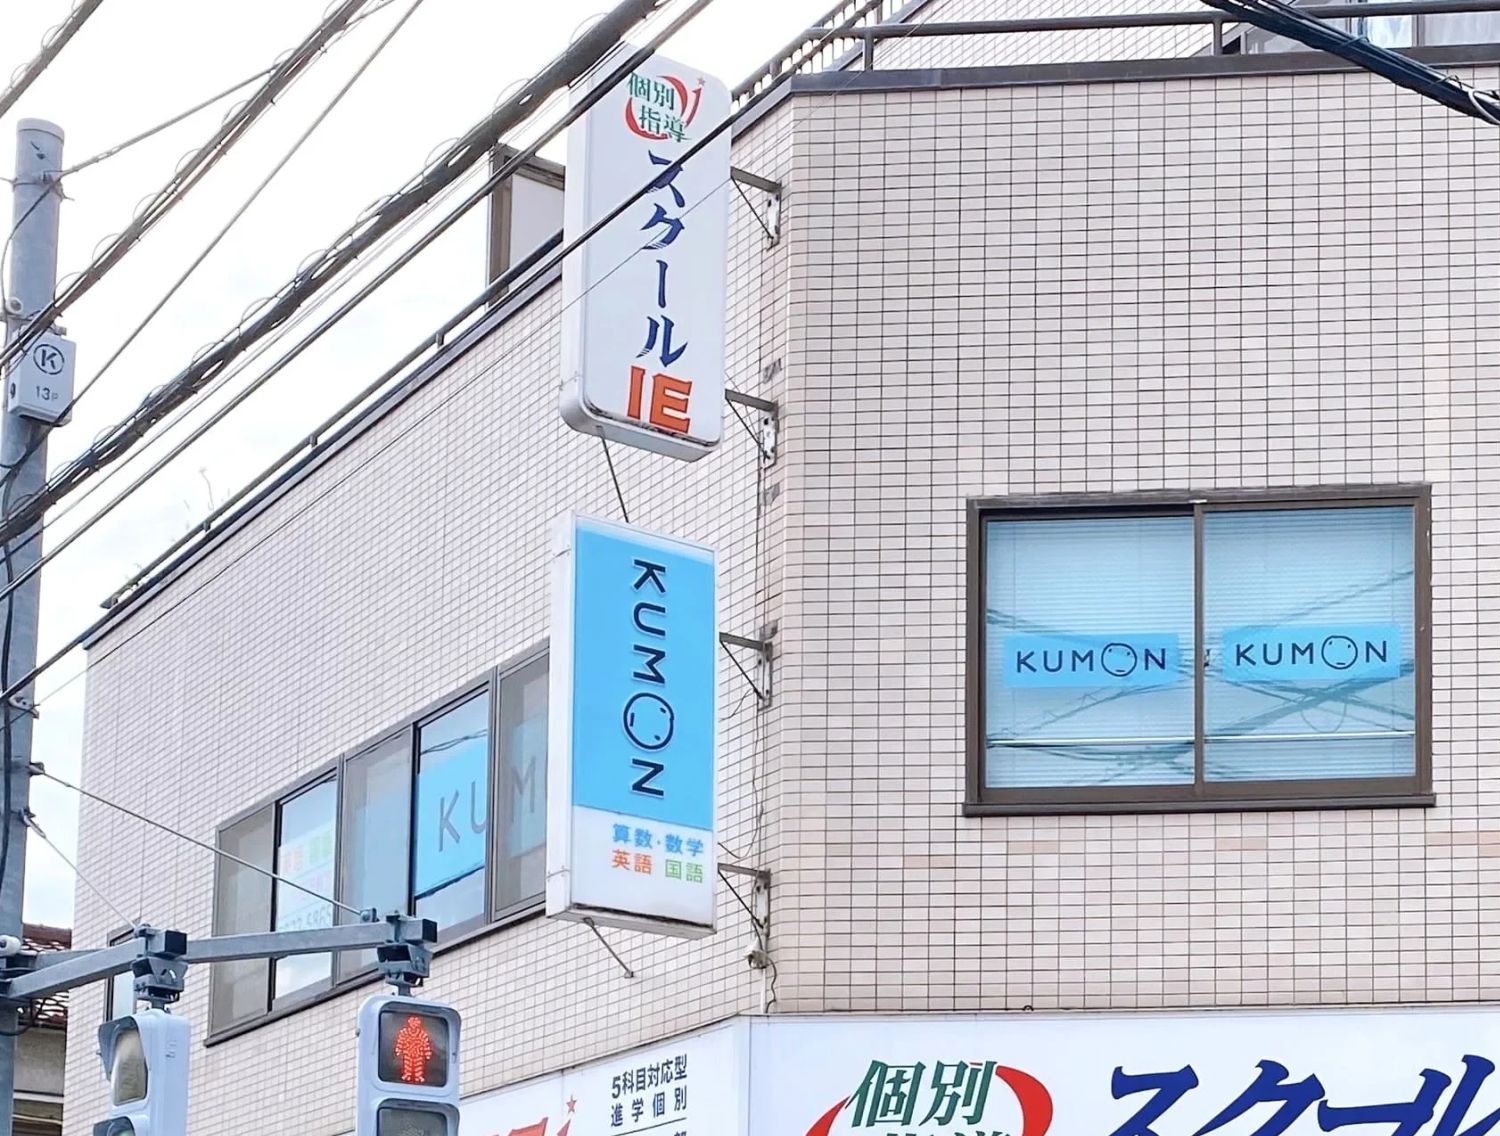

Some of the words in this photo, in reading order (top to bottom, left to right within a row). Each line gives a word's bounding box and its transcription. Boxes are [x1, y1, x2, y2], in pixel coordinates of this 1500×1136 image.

[627, 72, 675, 111] 個別
[639, 105, 692, 143] 指導
[1017, 642, 1166, 677] KUMON
[1235, 635, 1387, 669] KUMON
[623, 559, 674, 797] KUMON
[611, 849, 652, 875] 英語
[665, 859, 703, 883] 国語
[611, 1054, 687, 1099] 5科目対応型
[845, 1060, 998, 1127] 個別
[611, 1086, 687, 1127] 進学個別
